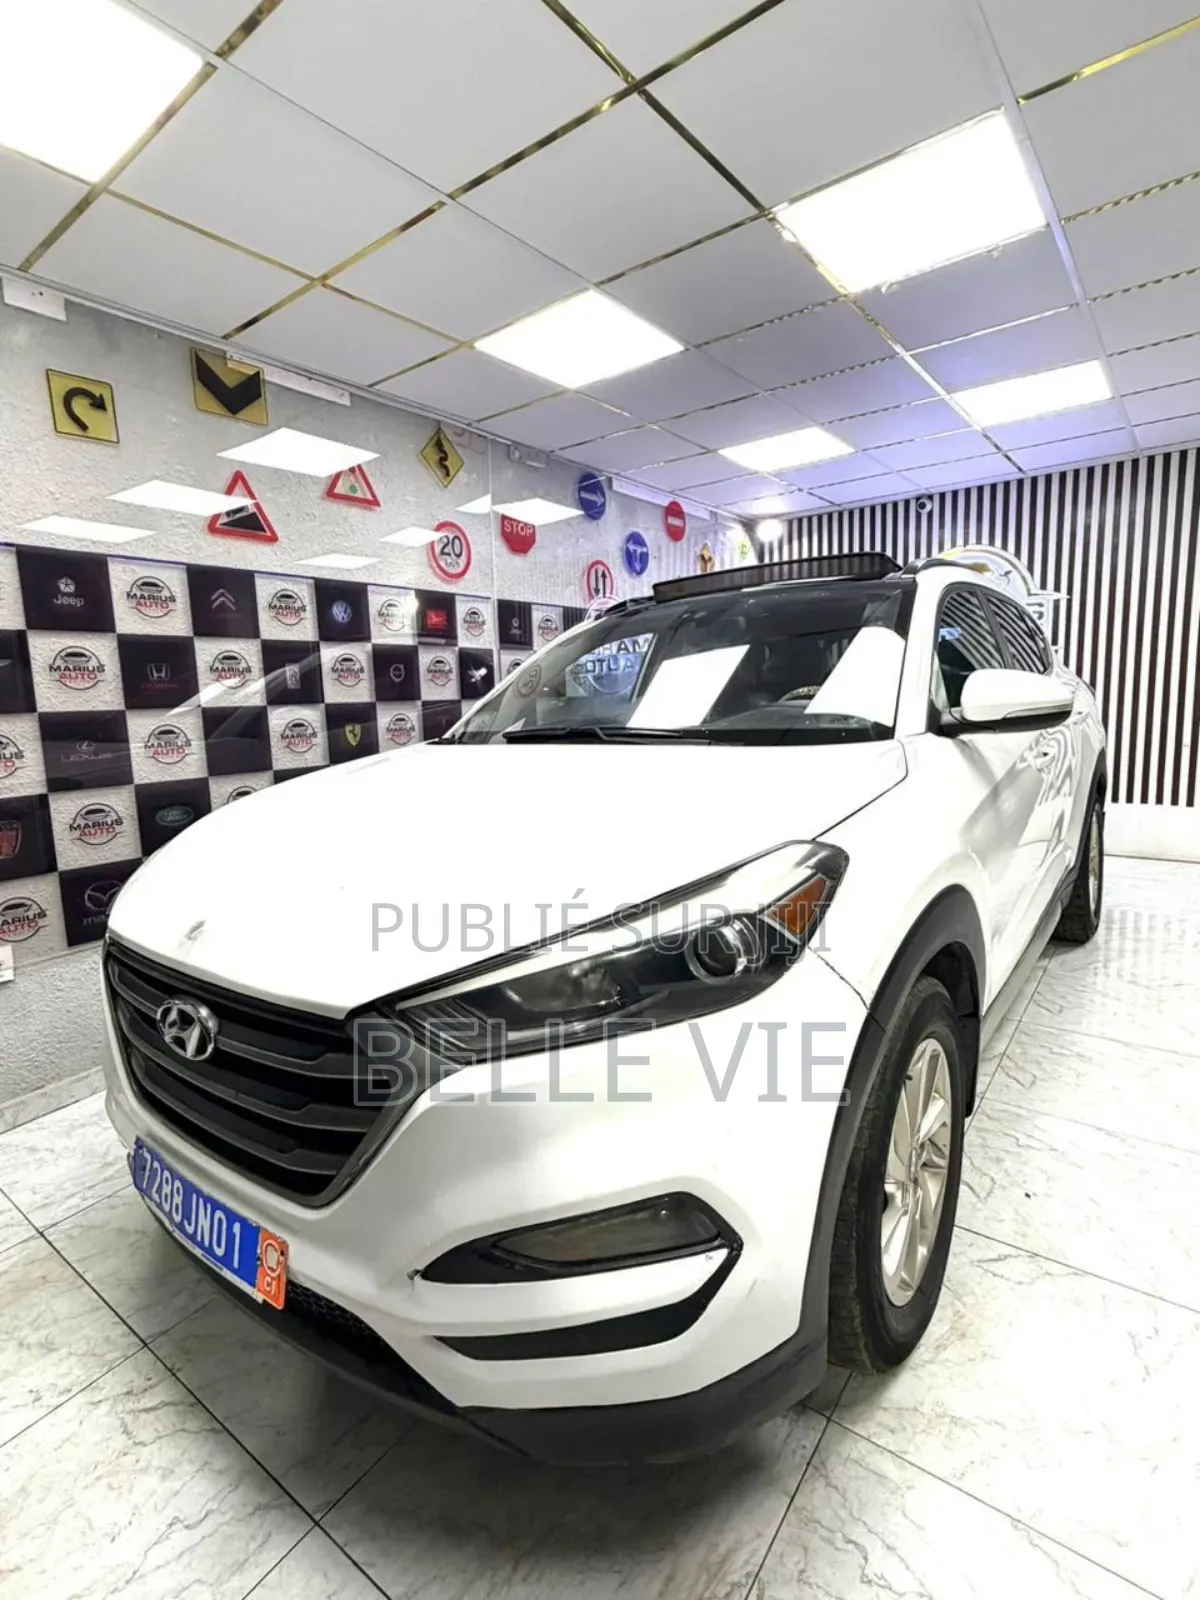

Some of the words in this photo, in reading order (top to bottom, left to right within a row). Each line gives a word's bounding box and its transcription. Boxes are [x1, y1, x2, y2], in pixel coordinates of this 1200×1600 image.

[504, 520, 534, 537] STOP
[440, 534, 463, 558] 20
[53, 594, 84, 607] Jeep
[126, 592, 176, 602] MARIUS
[135, 600, 170, 609] AUTO
[269, 604, 307, 612] MARIUS
[275, 610, 301, 618] AUTO
[49, 664, 105, 674] MARIUS
[210, 666, 252, 675] MARIUS
[59, 672, 98, 681] AUTO
[281, 732, 317, 740] MARIUS
[144, 740, 192, 750] MARIUS
[152, 747, 186, 757] AUTO
[69, 818, 124, 831] MARIUS
[79, 827, 116, 837] AUTO
[1, 911, 47, 927] ARIUS
